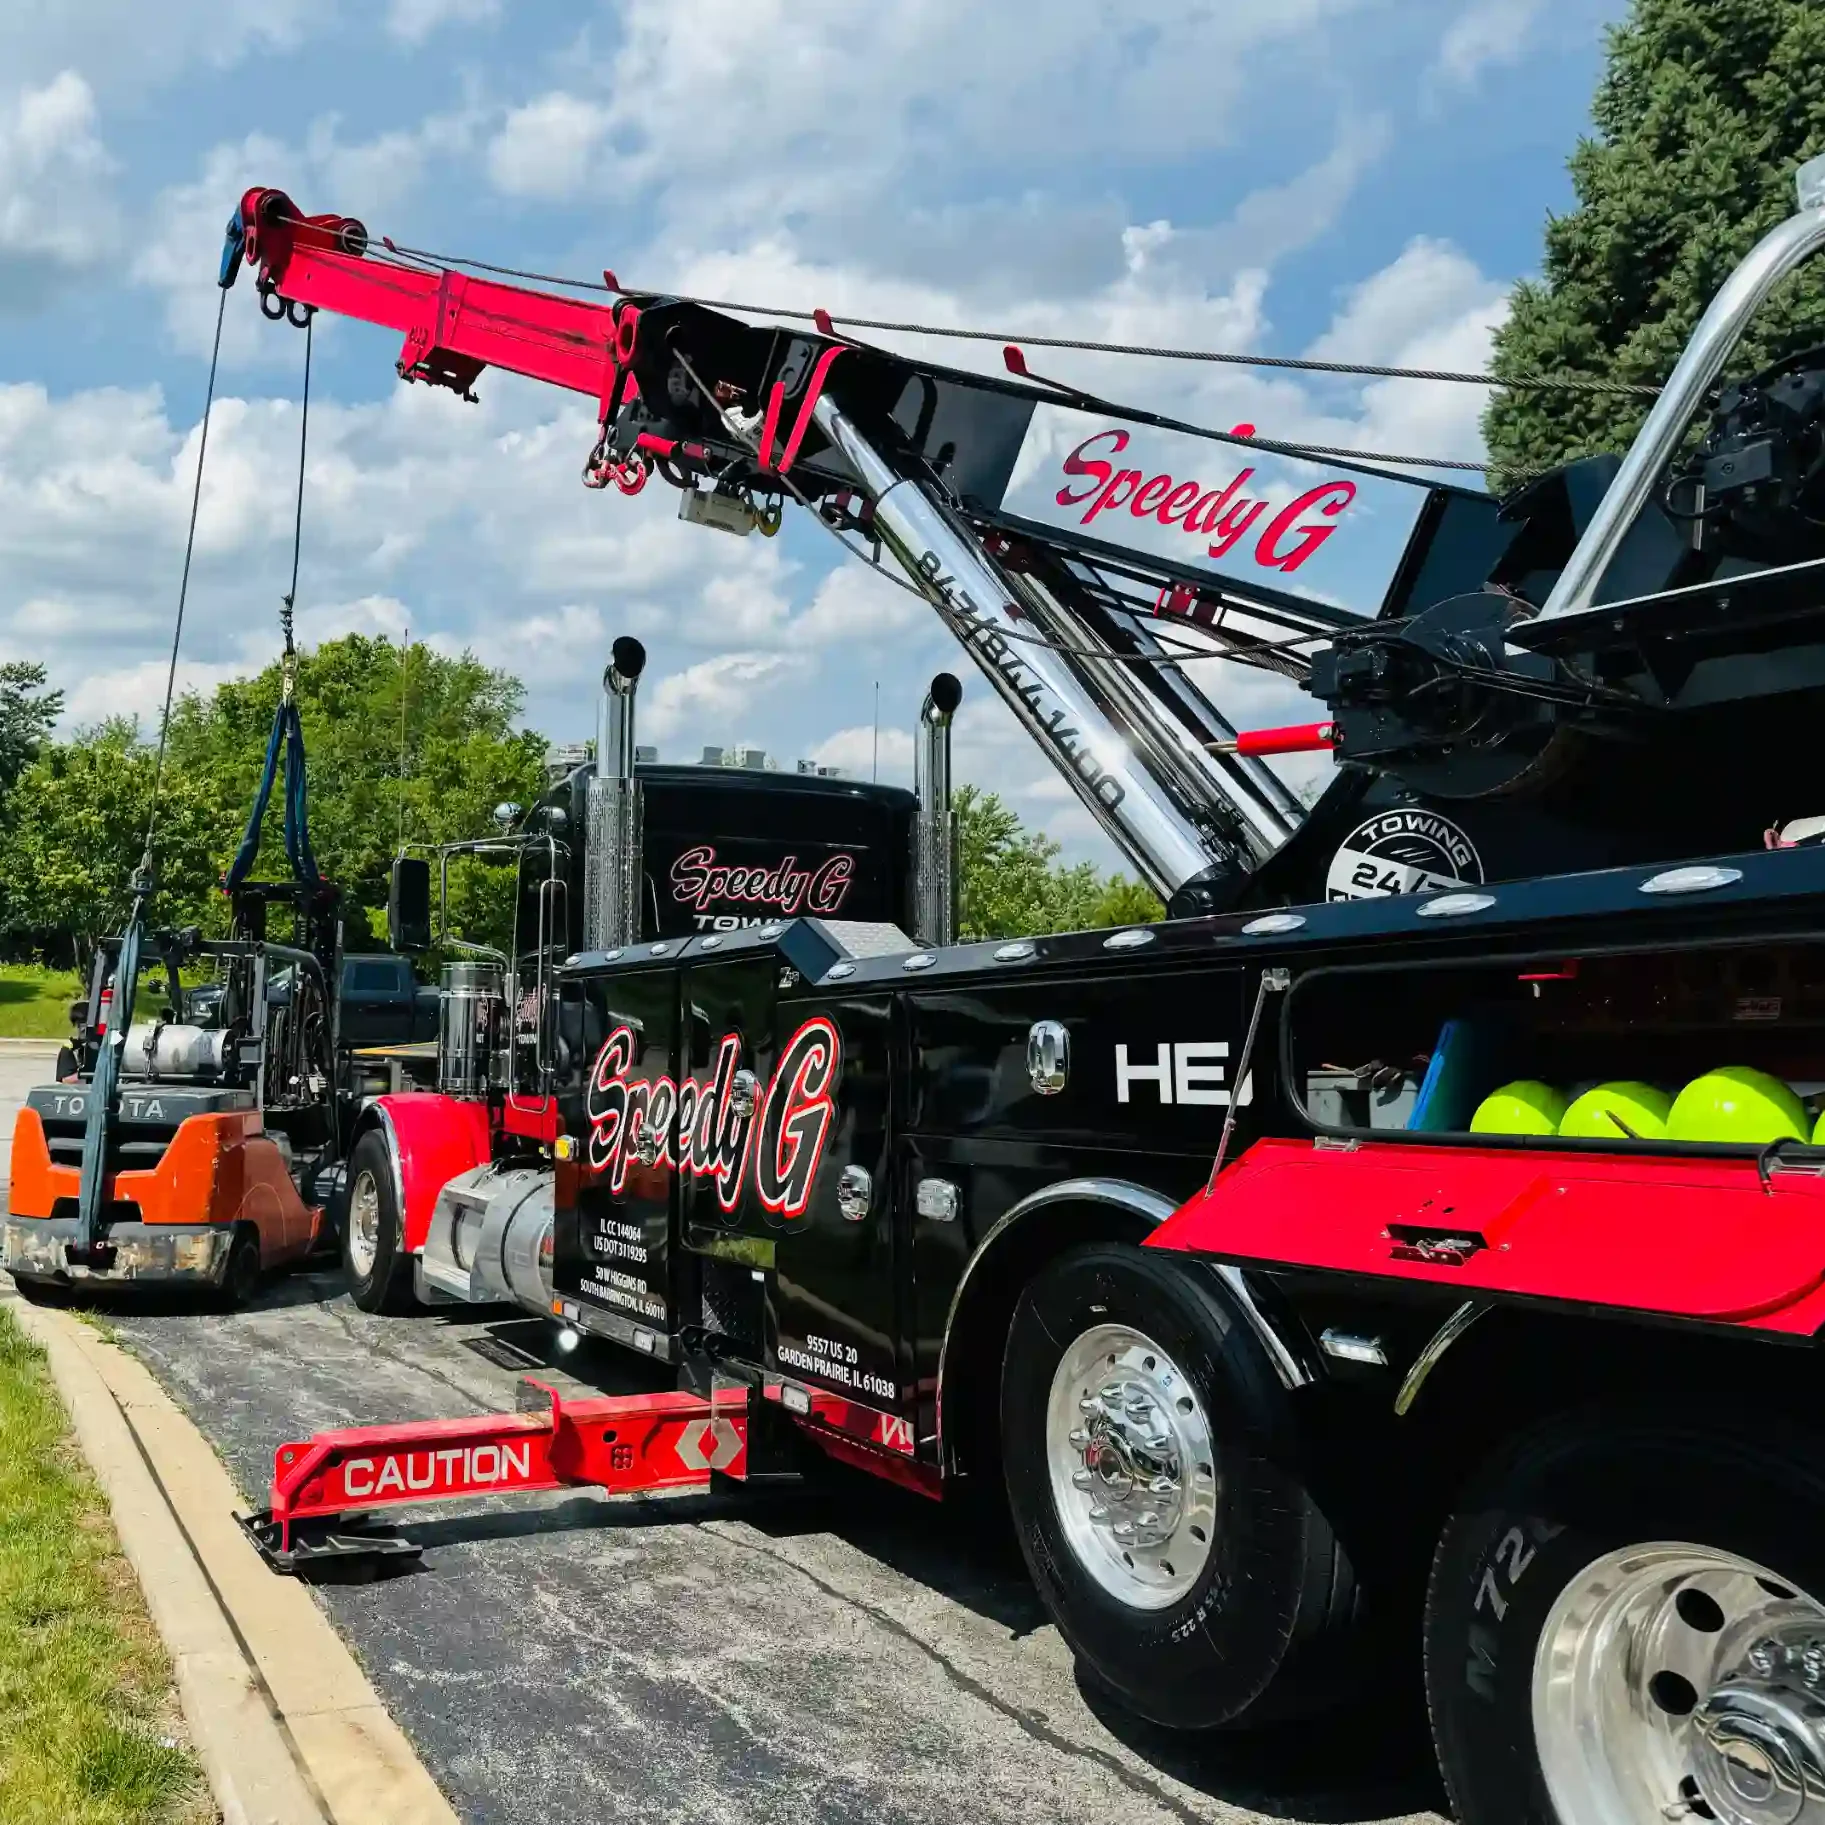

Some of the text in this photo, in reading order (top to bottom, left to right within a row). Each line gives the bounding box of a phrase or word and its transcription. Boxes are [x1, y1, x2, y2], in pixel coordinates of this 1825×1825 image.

[1055, 429, 1357, 572] Speedy G
[1361, 814, 1473, 868] TOWING
[669, 846, 856, 913] Speedy G
[54, 1096, 165, 1118] TOTA
[587, 1016, 836, 1219] Speedy G
[594, 1235, 648, 1264] US DOT 3119295
[600, 1218, 641, 1242] IL CC 144064
[580, 1278, 599, 1297] SOUTH
[638, 1299, 645, 1314] IL
[645, 1302, 665, 1321] 60010
[595, 1265, 647, 1294] 50 W HIGGINS RD
[777, 1345, 896, 1400] GARDEN PRAIRIE, IL 61038
[806, 1334, 858, 1365] 9557 US 20
[344, 1442, 530, 1497] CAUTION
